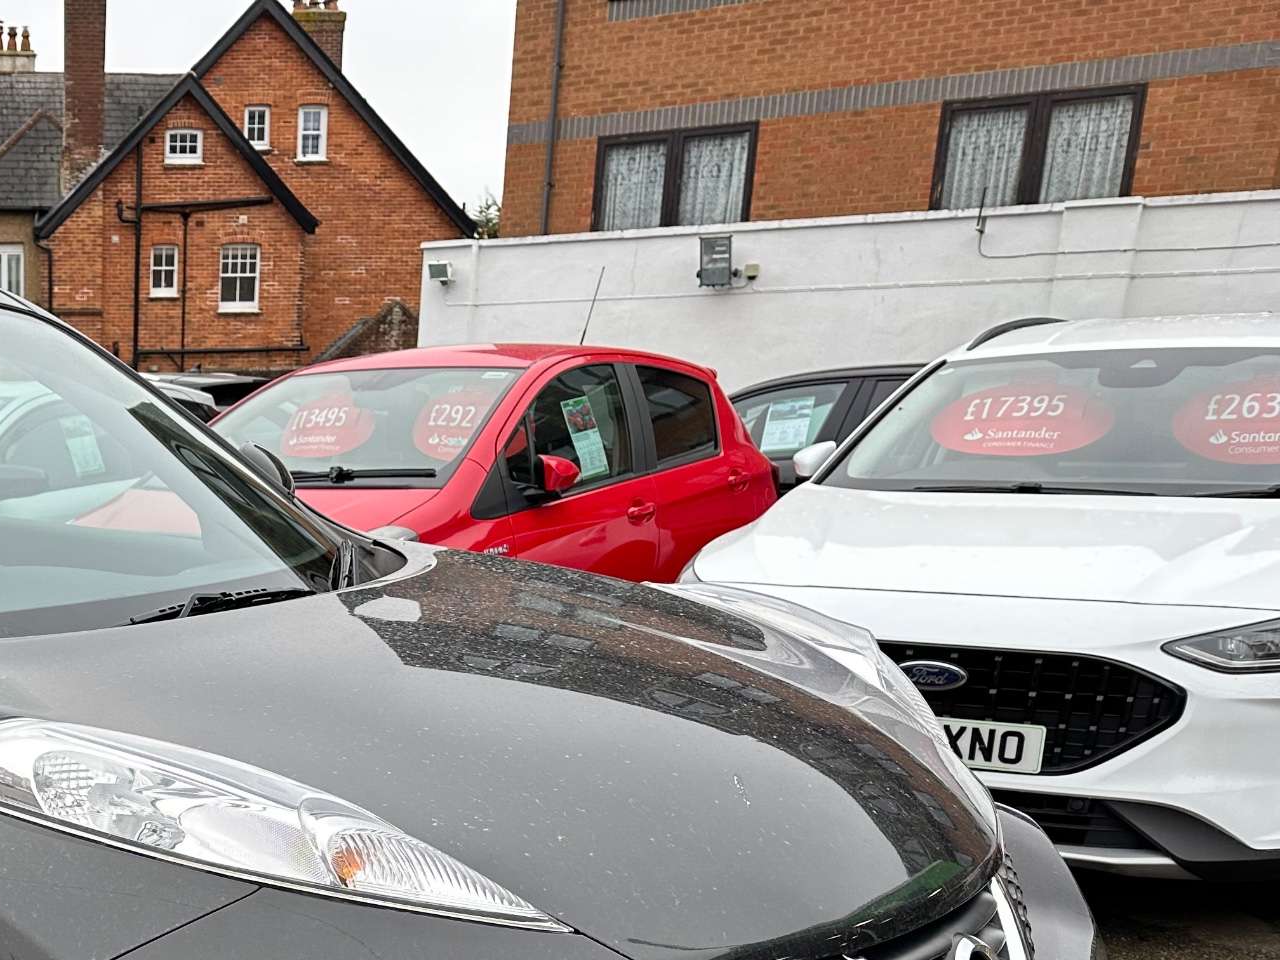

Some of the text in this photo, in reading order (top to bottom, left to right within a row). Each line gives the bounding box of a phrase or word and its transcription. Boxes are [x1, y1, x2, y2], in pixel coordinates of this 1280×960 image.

[427, 404, 476, 427] £292
[963, 394, 1068, 421] £17395
[984, 427, 1062, 440] Santander
[909, 665, 946, 685] Ford
